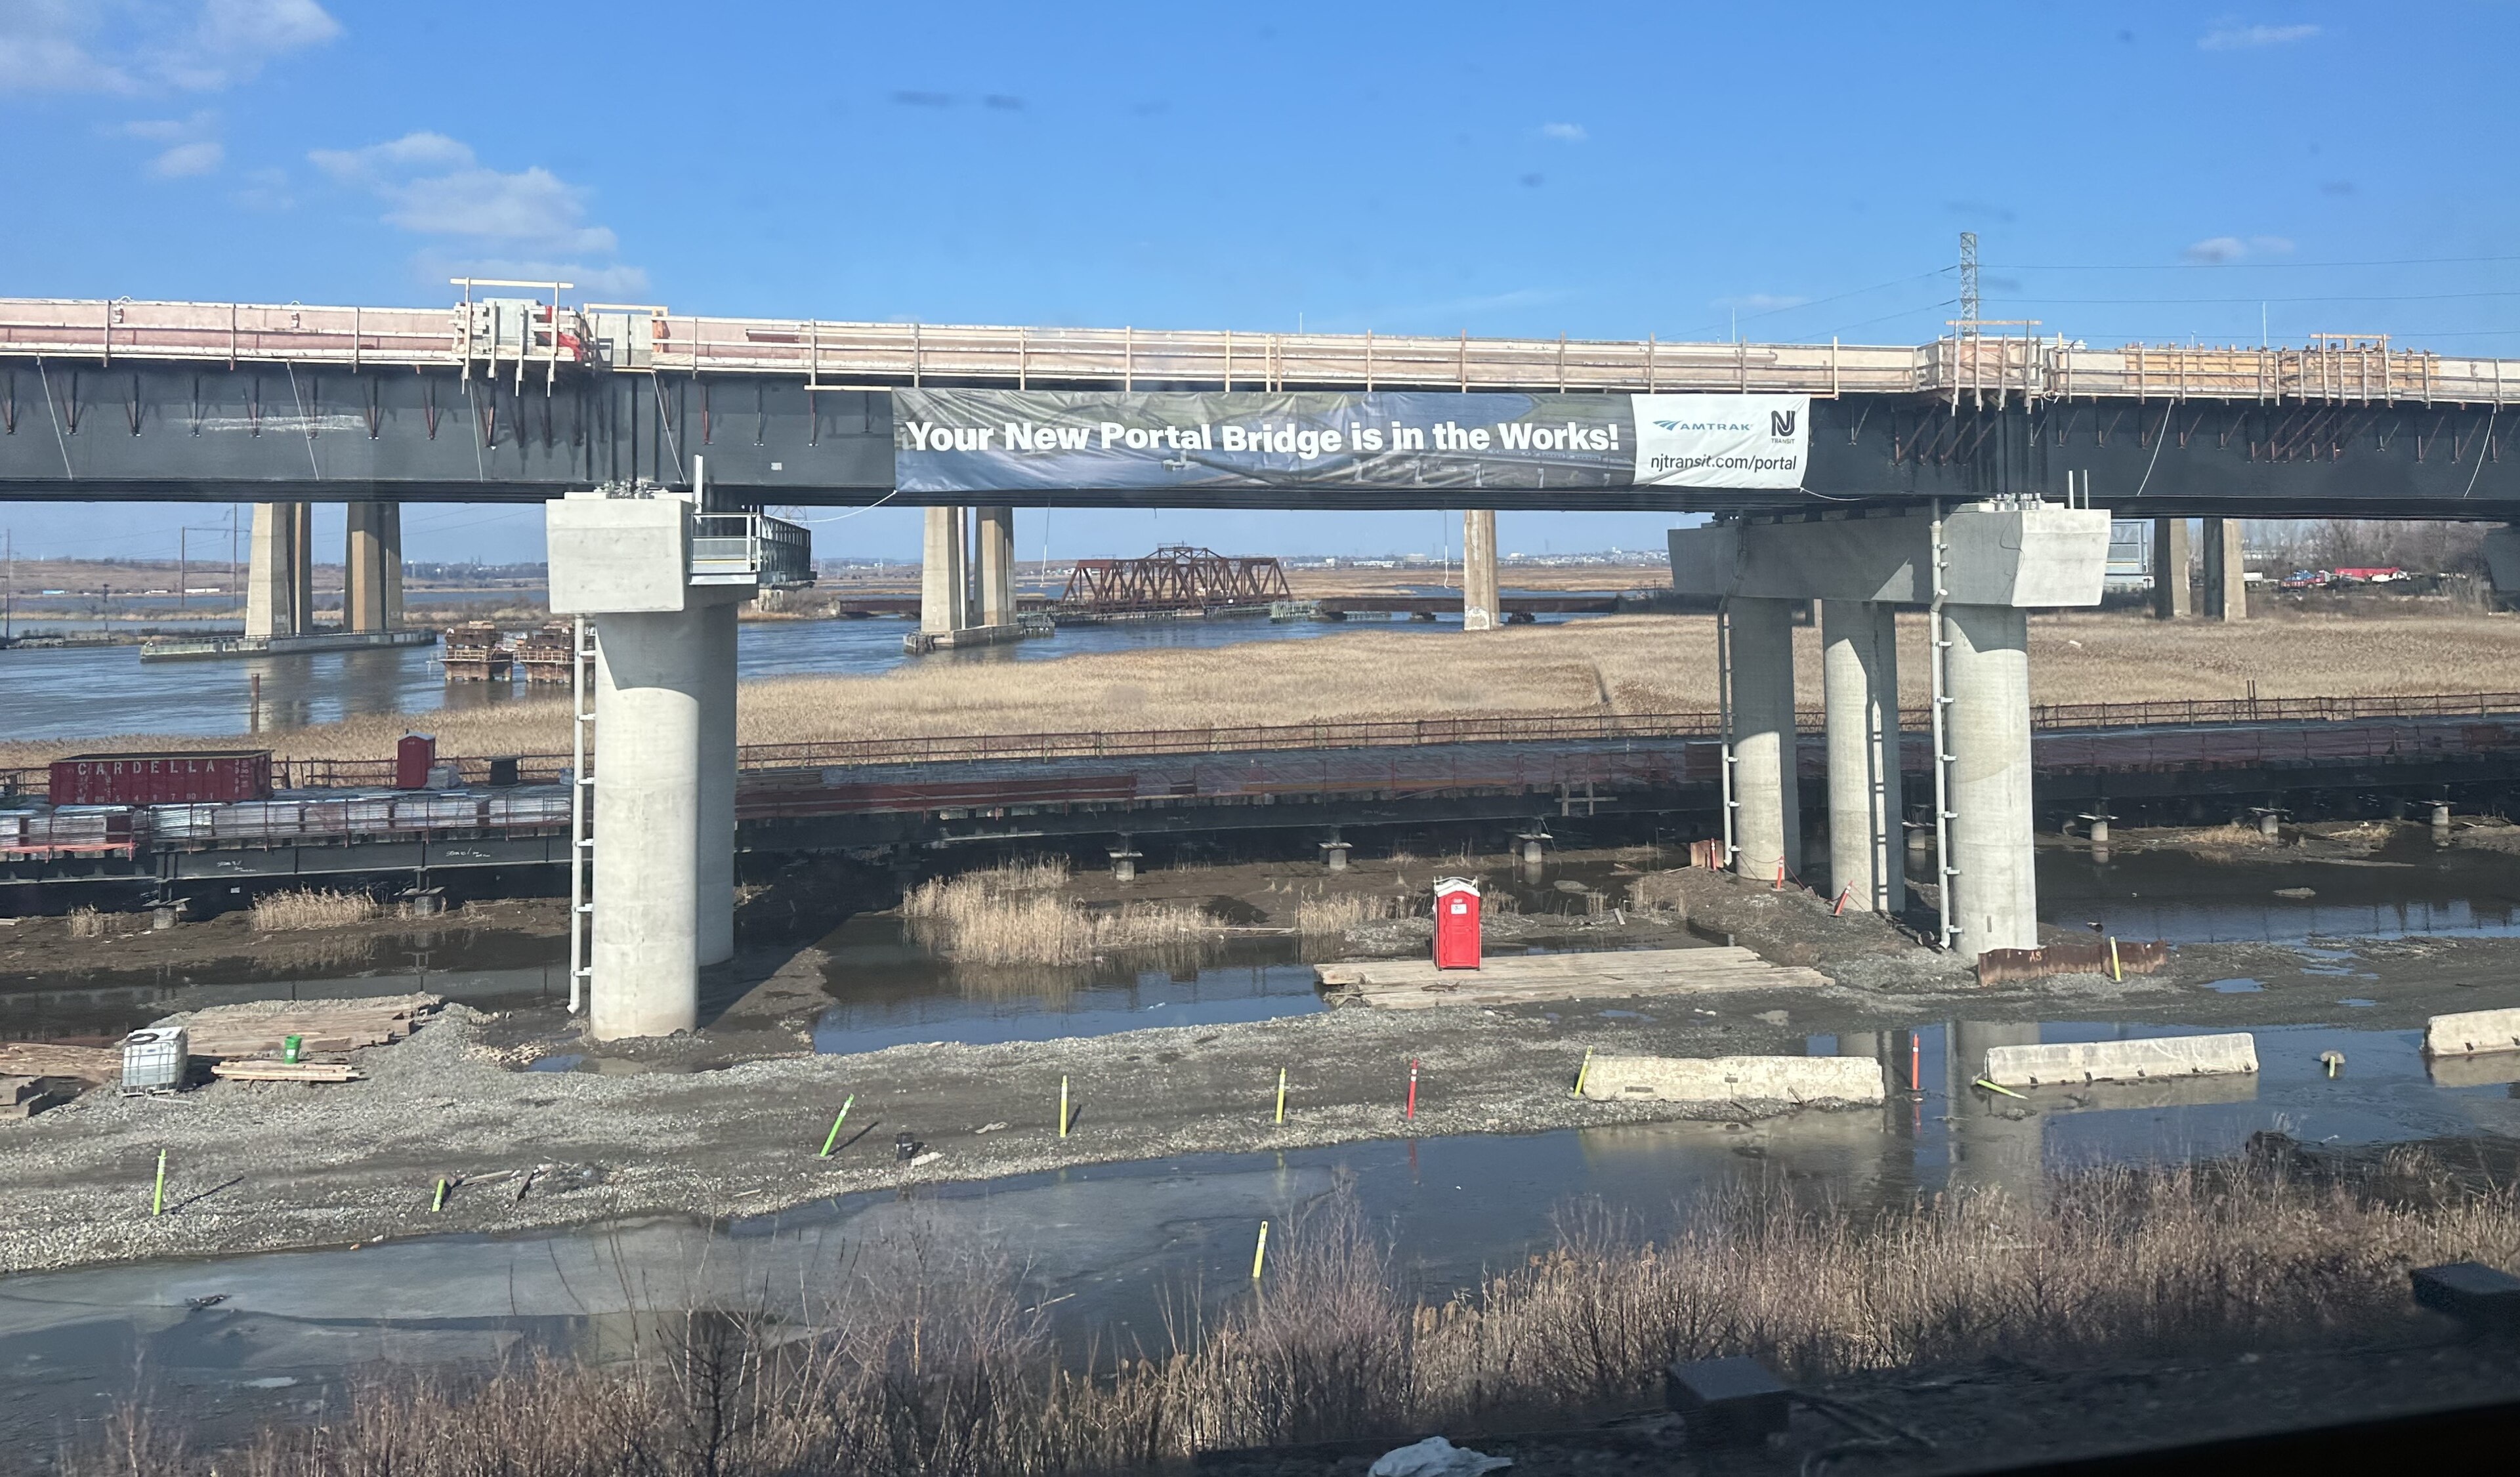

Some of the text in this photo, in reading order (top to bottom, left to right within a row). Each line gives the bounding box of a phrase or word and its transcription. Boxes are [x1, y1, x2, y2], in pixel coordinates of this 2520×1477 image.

[1771, 410, 1796, 436] NJ
[906, 421, 1619, 459] Your New Portal Bridge is in the Works!
[1651, 454, 1796, 472] njtransit.com/portal
[78, 760, 215, 775] CARDELLA
